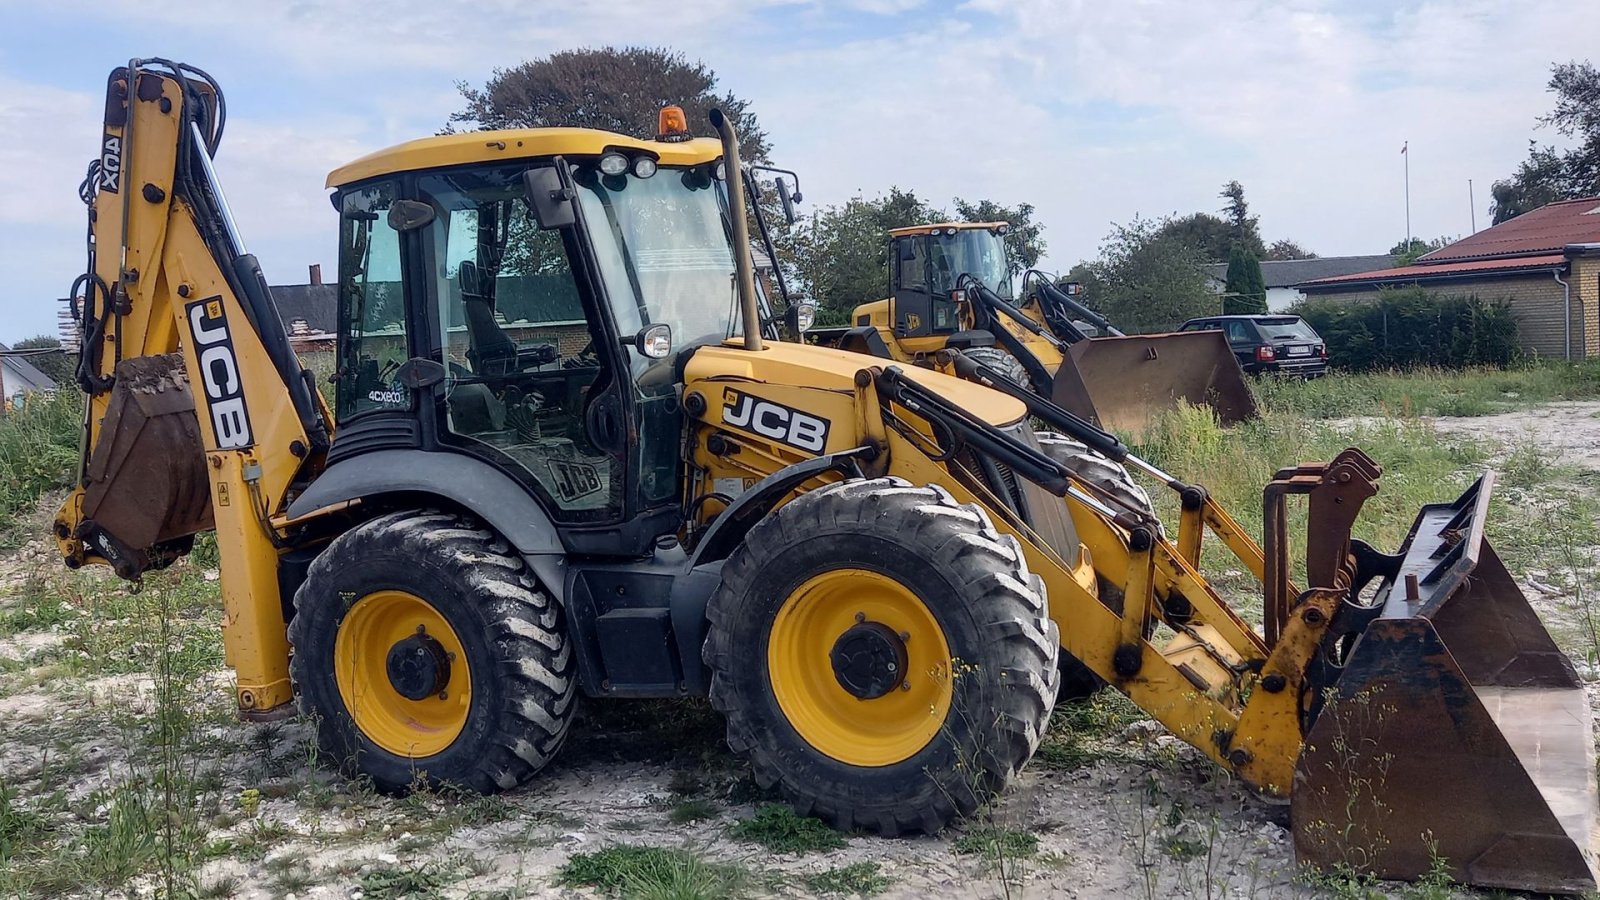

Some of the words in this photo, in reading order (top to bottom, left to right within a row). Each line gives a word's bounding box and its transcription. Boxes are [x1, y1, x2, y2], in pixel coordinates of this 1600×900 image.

[101, 138, 120, 189] 4CX
[190, 305, 250, 448] JCB
[722, 395, 826, 452] JCB
[557, 464, 599, 498] JCB
